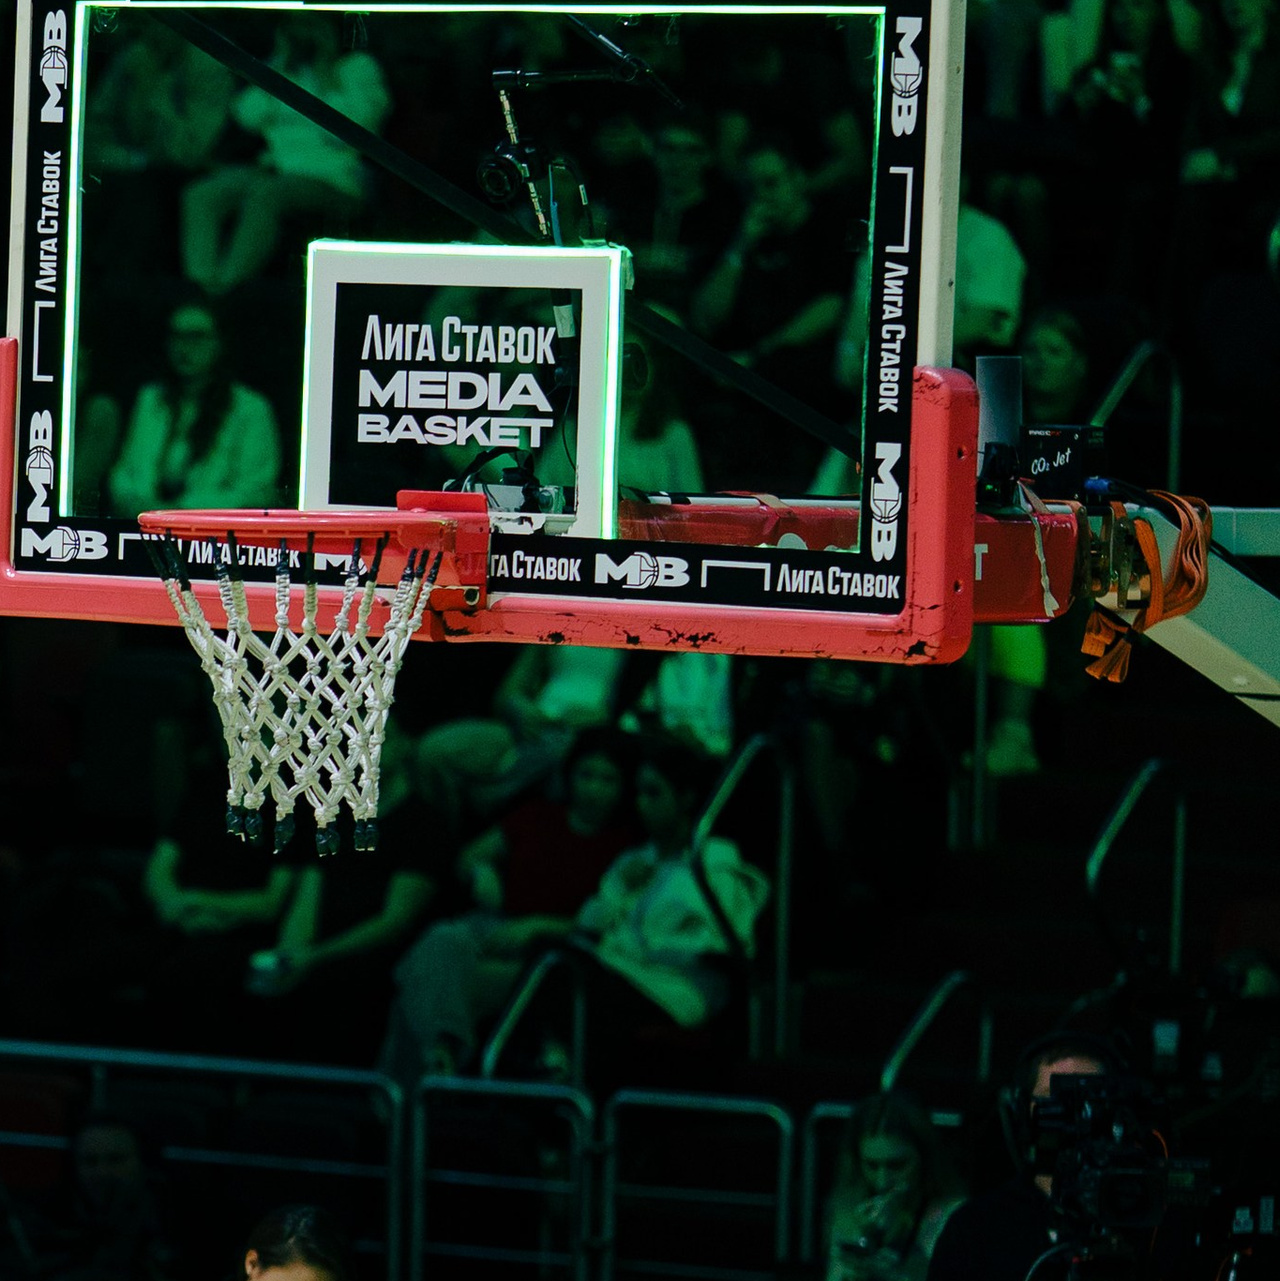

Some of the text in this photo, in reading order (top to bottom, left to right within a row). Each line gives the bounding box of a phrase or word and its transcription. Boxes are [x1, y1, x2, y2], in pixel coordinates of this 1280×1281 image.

[358, 369, 554, 412] MEDIA
[357, 413, 554, 448] BASKET
[1052, 447, 1071, 467] Jet
